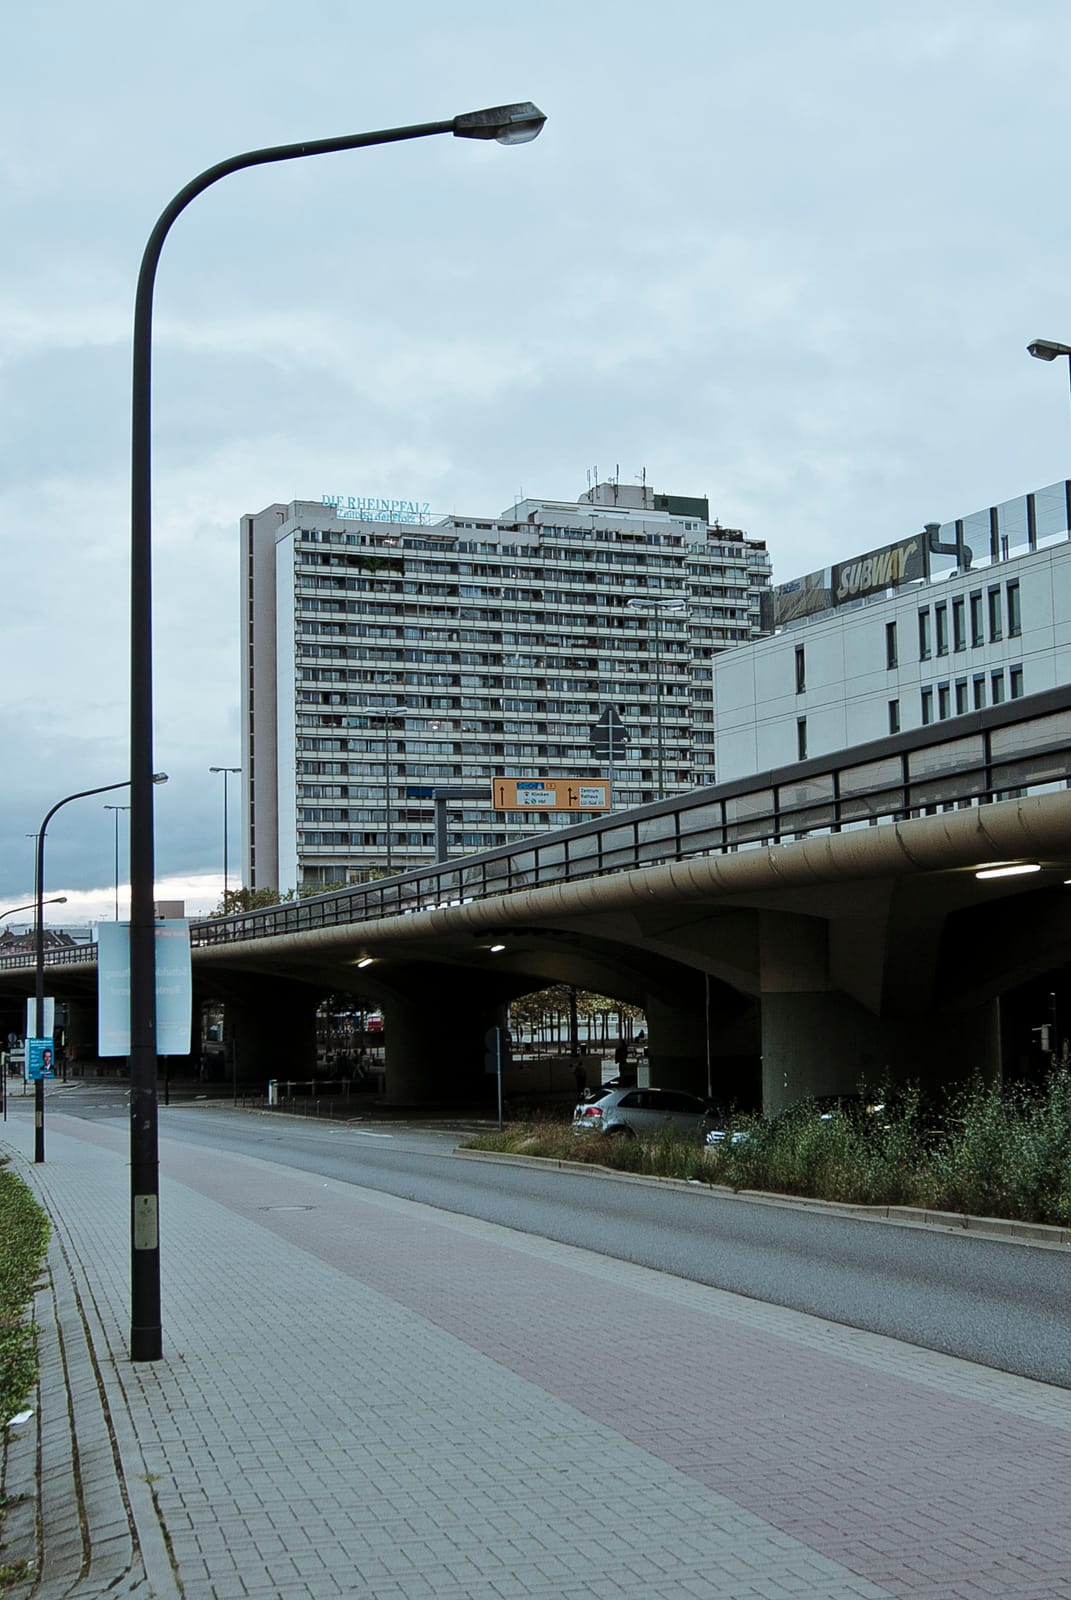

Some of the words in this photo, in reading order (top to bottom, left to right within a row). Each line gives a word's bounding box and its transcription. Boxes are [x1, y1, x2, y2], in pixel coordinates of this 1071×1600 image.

[321, 494, 344, 507] DIE
[347, 496, 430, 513] RHEINPFALZ
[836, 540, 918, 600] SUBWAY
